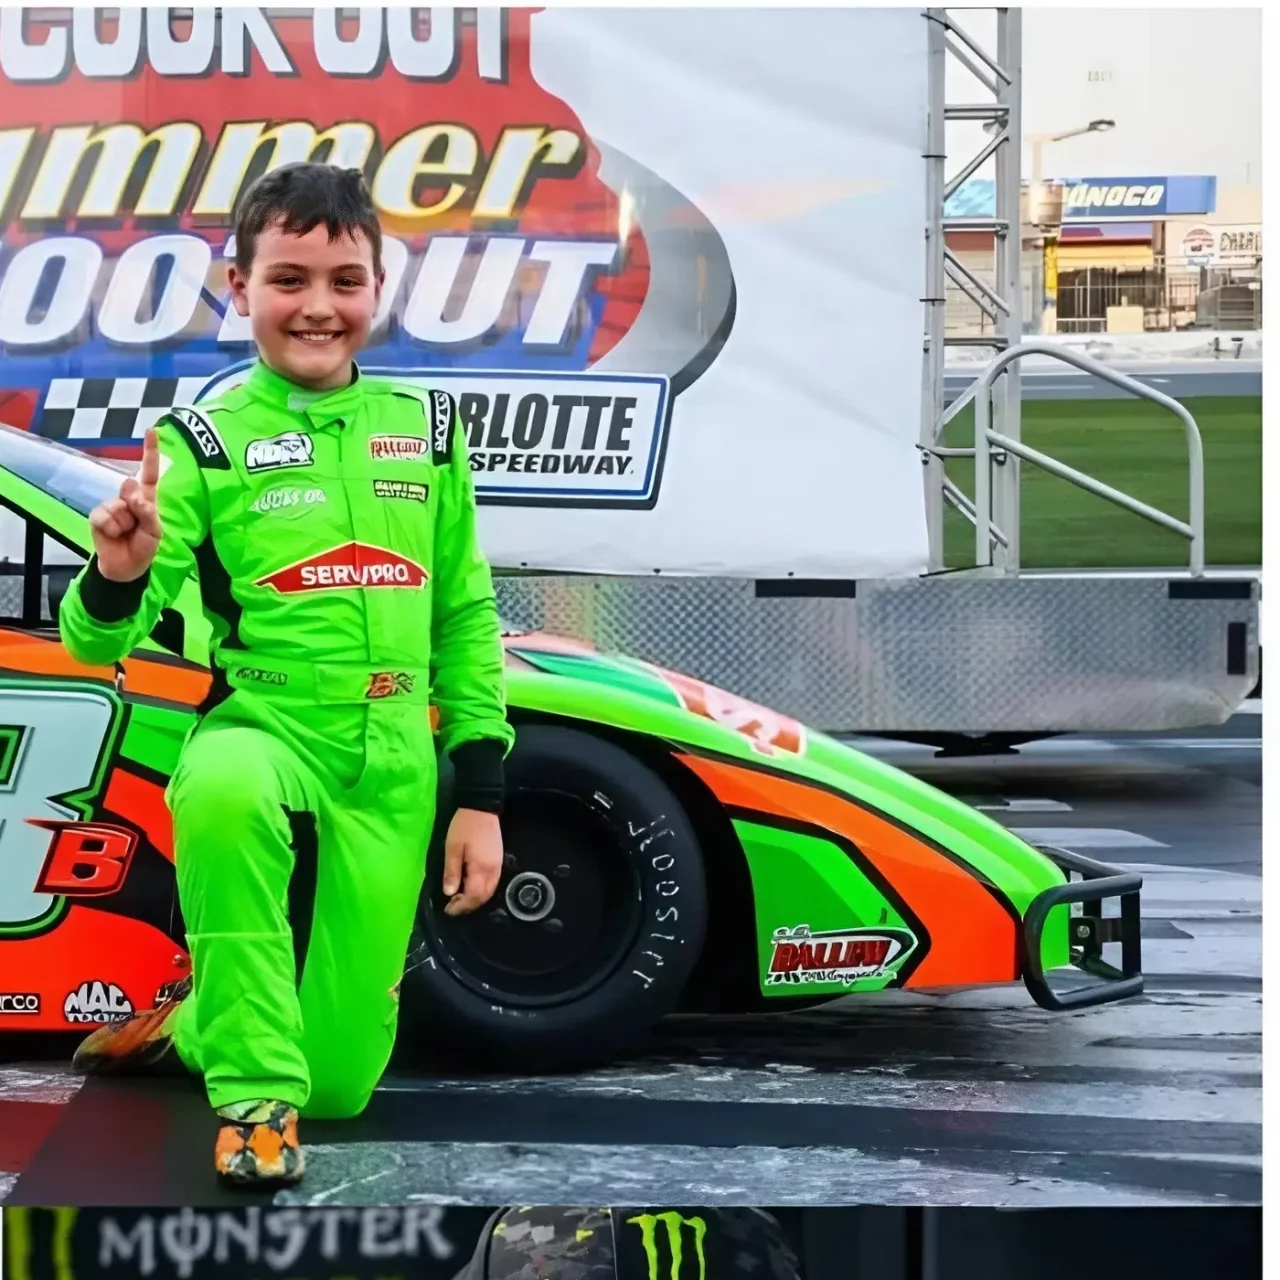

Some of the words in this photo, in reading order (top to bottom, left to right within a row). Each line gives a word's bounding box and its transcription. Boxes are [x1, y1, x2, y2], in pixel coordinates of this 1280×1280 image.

[459, 392, 637, 451] RLOTTE
[300, 563, 409, 587] SERVPRO
[34, 819, 137, 897] B
[64, 980, 131, 1012] MAC
[98, 1207, 454, 1279] MONSTER
